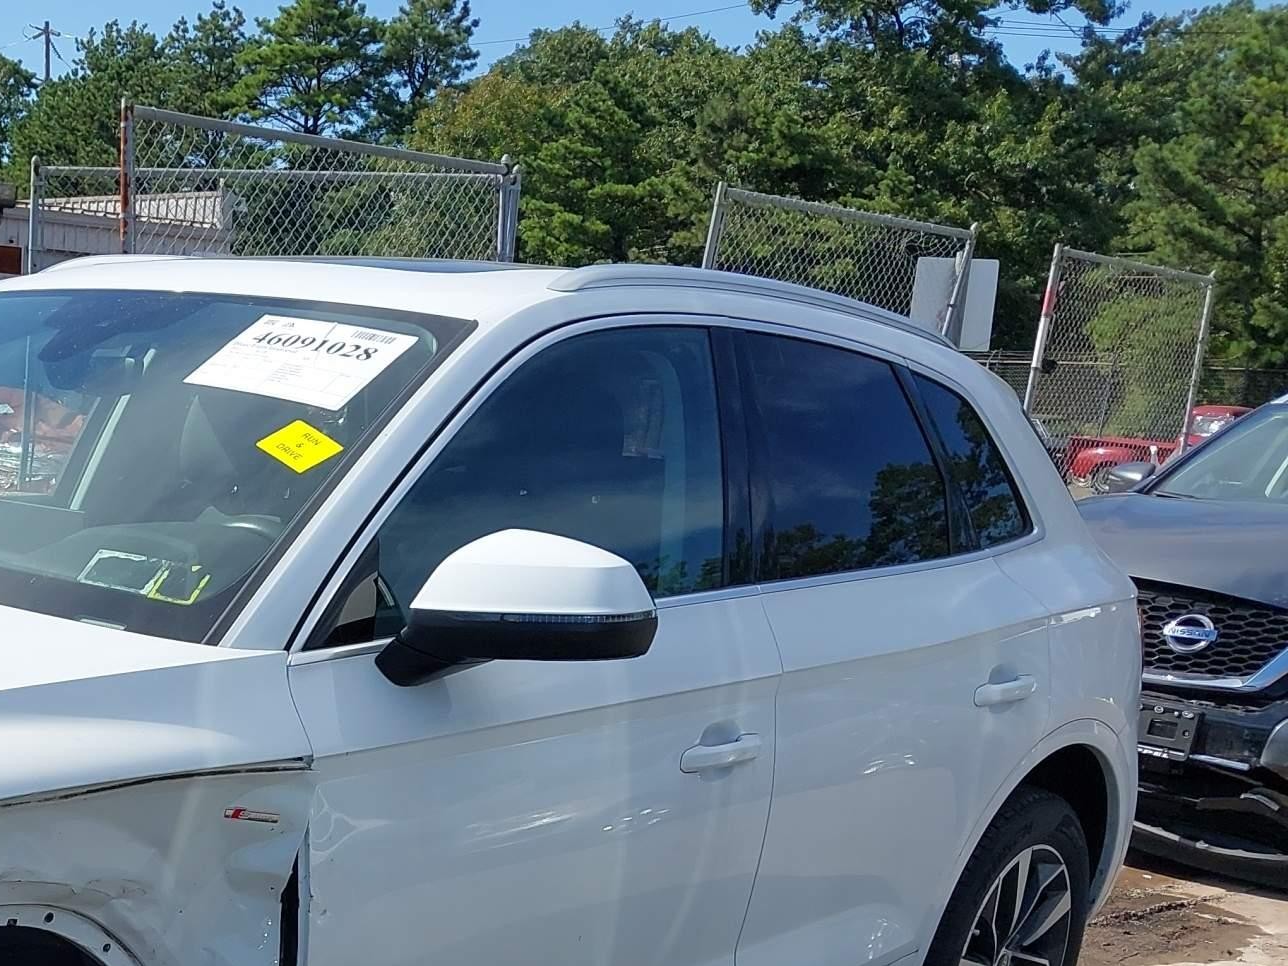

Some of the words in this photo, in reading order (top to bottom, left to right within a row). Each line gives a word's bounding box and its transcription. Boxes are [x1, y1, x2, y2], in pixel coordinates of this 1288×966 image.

[252, 331, 378, 361] 46091028
[303, 432, 321, 446] RUN
[276, 442, 304, 461] DRIVE
[1167, 627, 1210, 638] NISSAN
